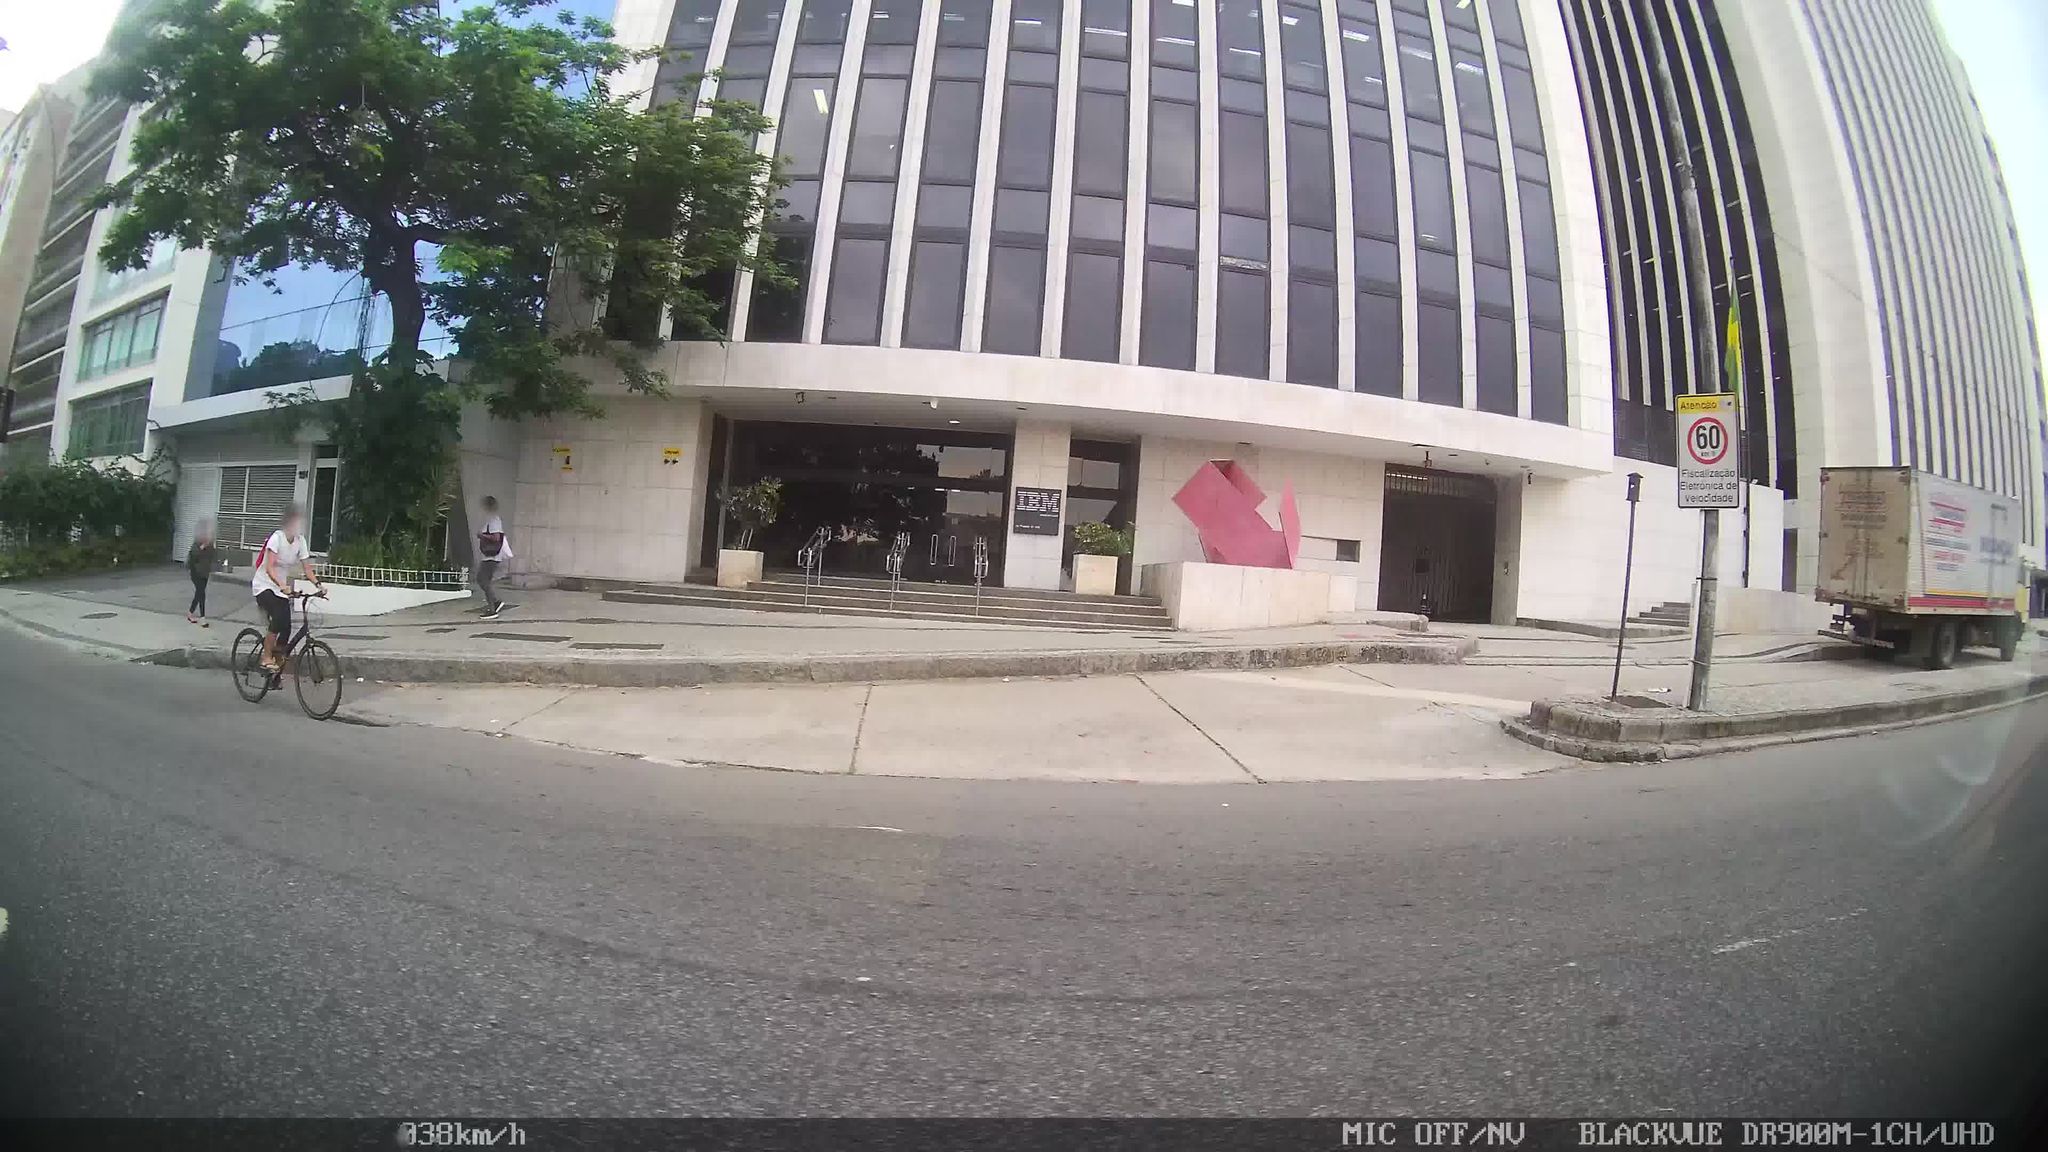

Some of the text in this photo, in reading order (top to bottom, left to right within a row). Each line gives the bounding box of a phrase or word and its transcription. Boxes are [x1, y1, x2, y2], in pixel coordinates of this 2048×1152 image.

[1695, 425, 1720, 450] 60
[1681, 468, 1736, 479] Fiscalização
[1726, 482, 1737, 490] de
[1016, 491, 1060, 513] IBM
[1685, 493, 1733, 503] Velocidade
